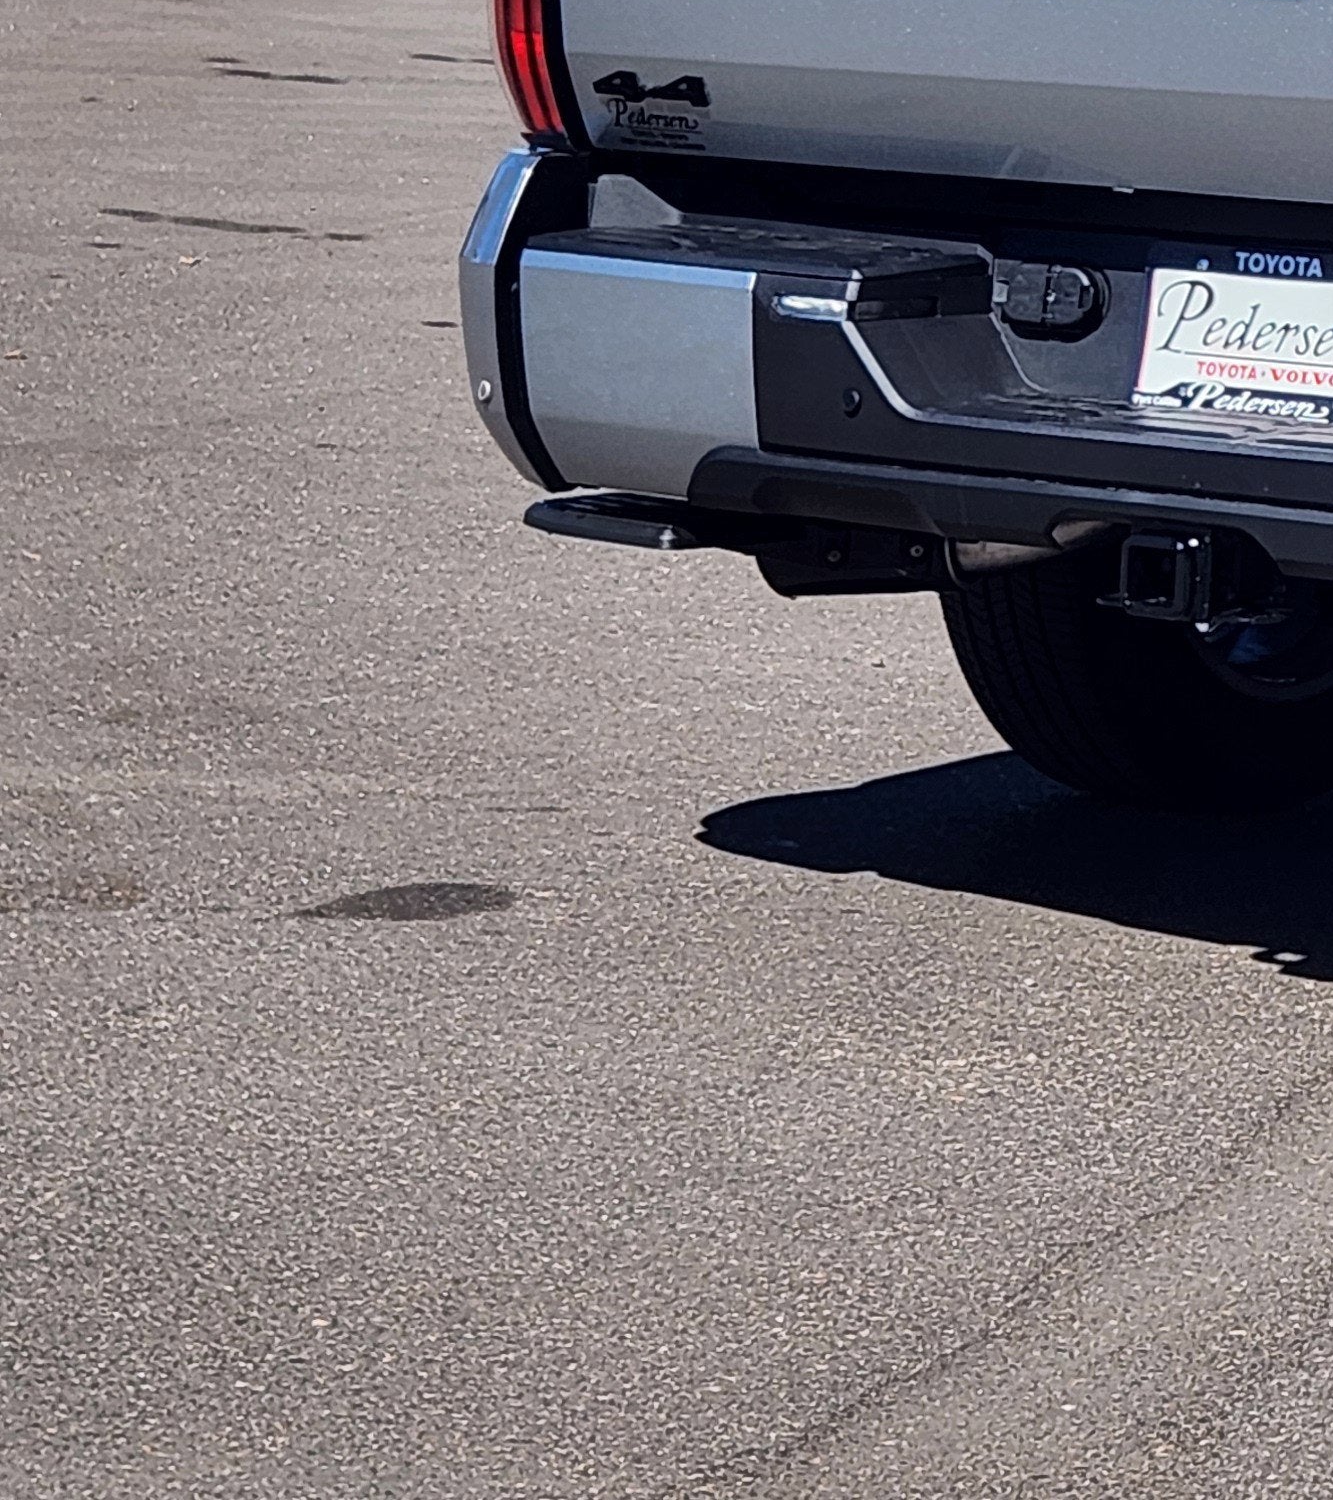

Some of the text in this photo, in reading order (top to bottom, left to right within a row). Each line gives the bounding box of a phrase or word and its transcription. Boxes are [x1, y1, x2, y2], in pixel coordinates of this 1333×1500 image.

[607, 97, 699, 129] Pedersen
[1235, 251, 1323, 278] TOYOTA
[1196, 360, 1257, 381] TOYOTA
[1186, 380, 1330, 420] Pedersen
